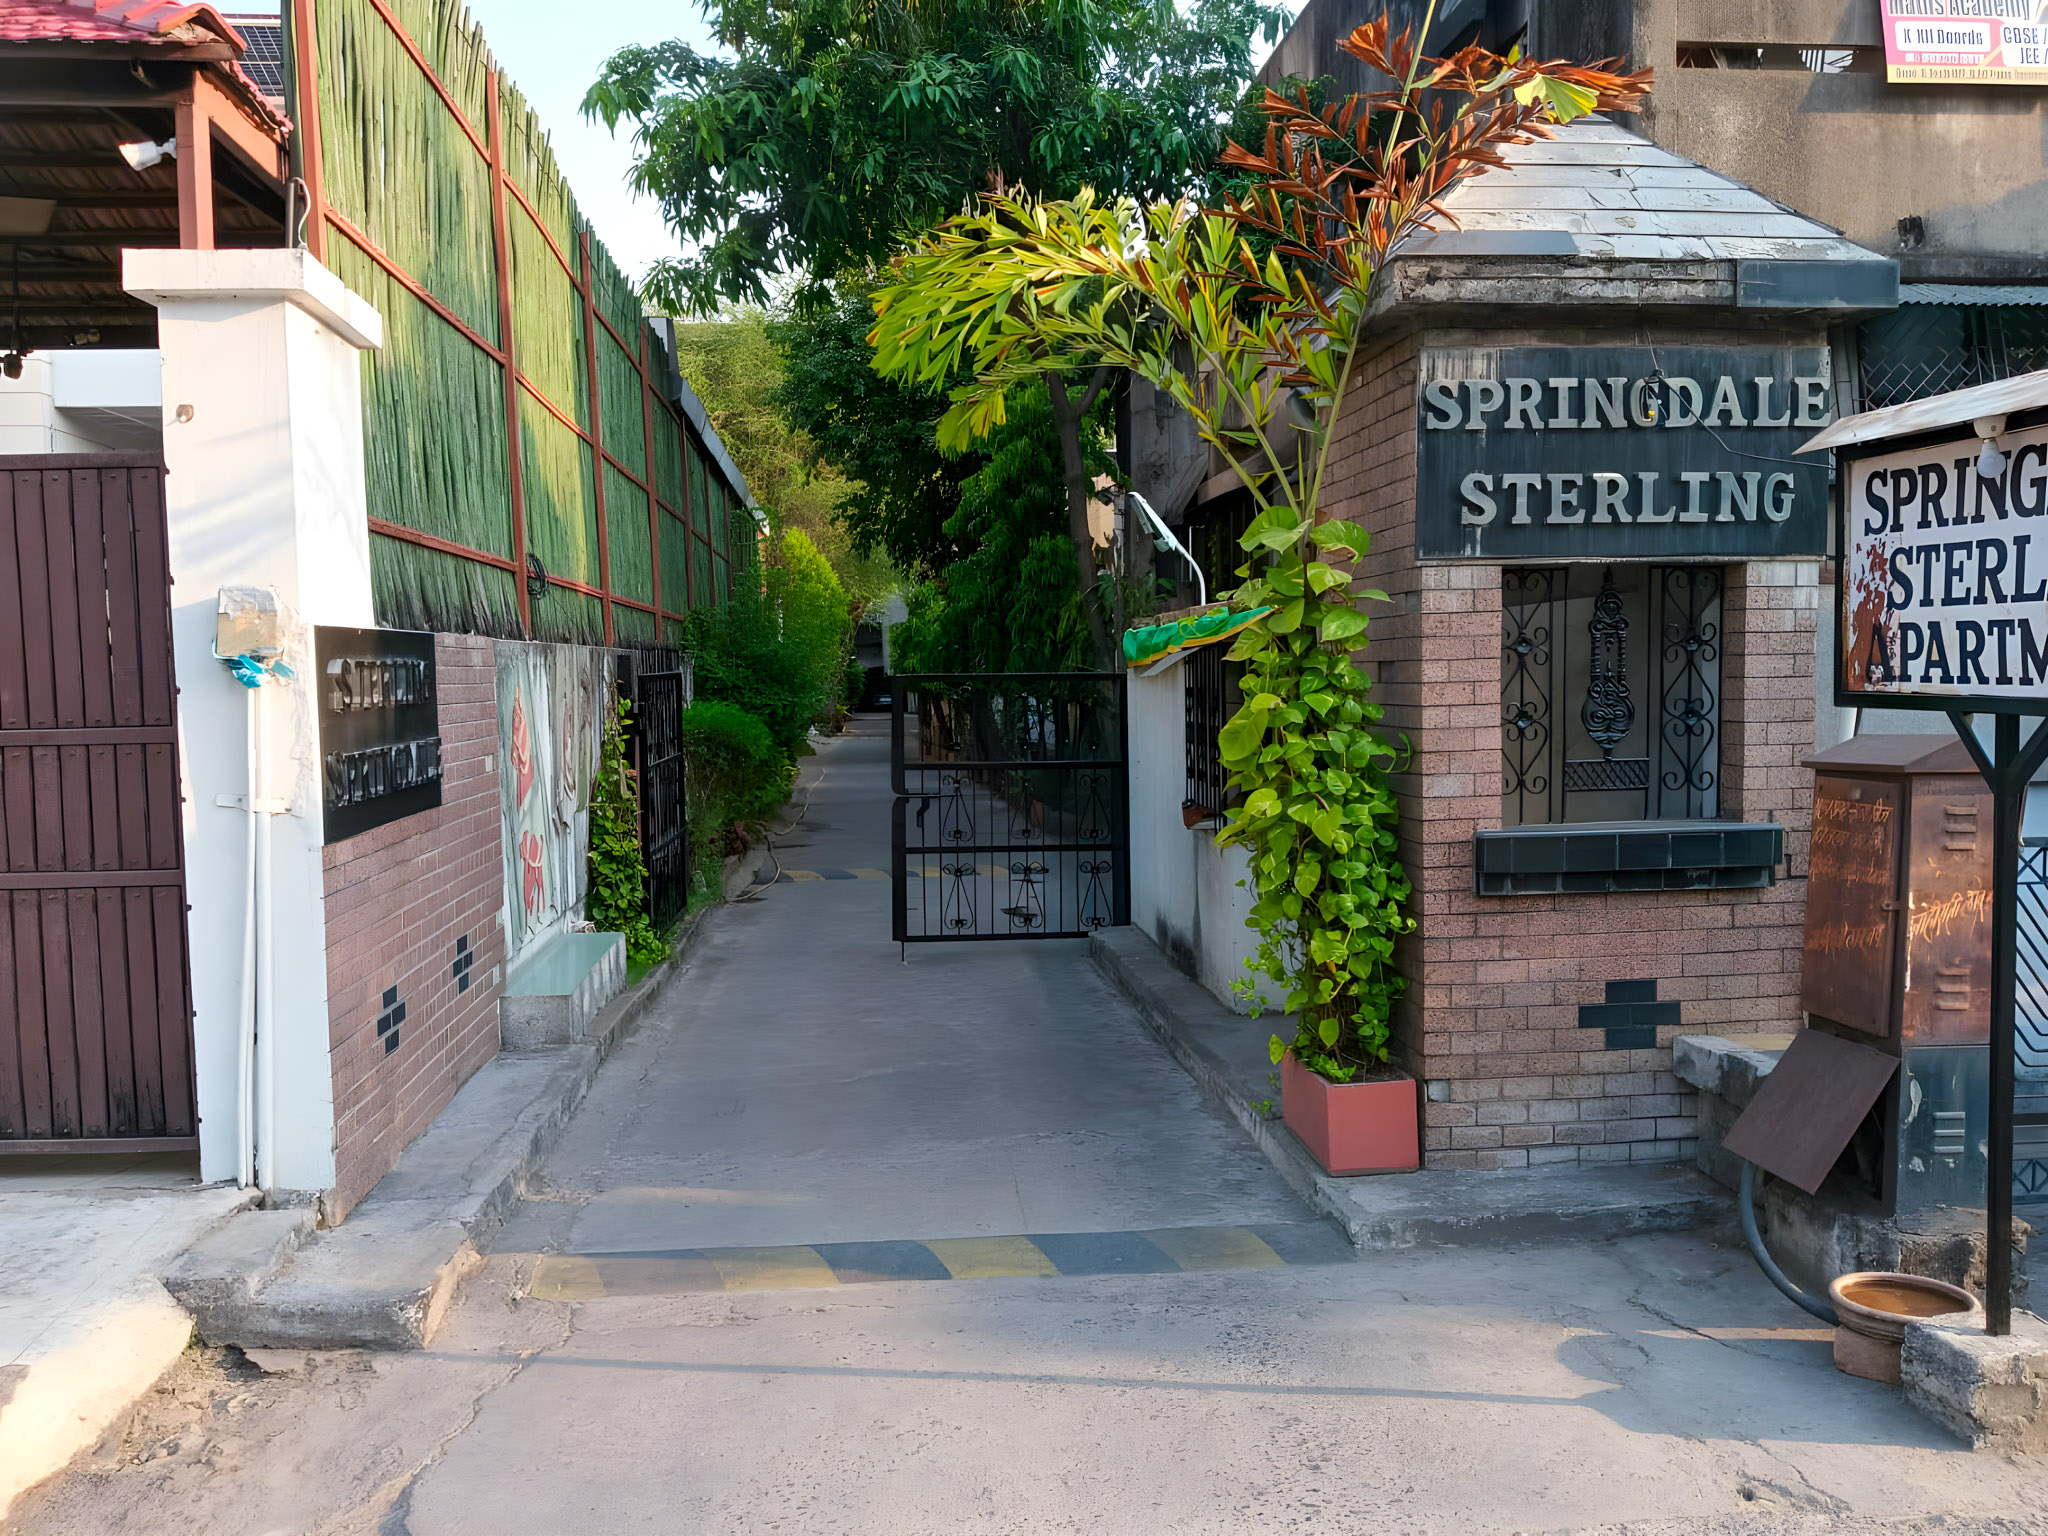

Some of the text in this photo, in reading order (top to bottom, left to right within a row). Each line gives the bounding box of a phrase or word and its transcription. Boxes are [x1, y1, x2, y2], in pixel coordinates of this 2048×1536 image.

[1425, 376, 1832, 430] SPRINGDALE
[1460, 472, 1796, 525] STERLING
[1864, 442, 2048, 537] SPRING
[1886, 534, 2048, 612] STERL
